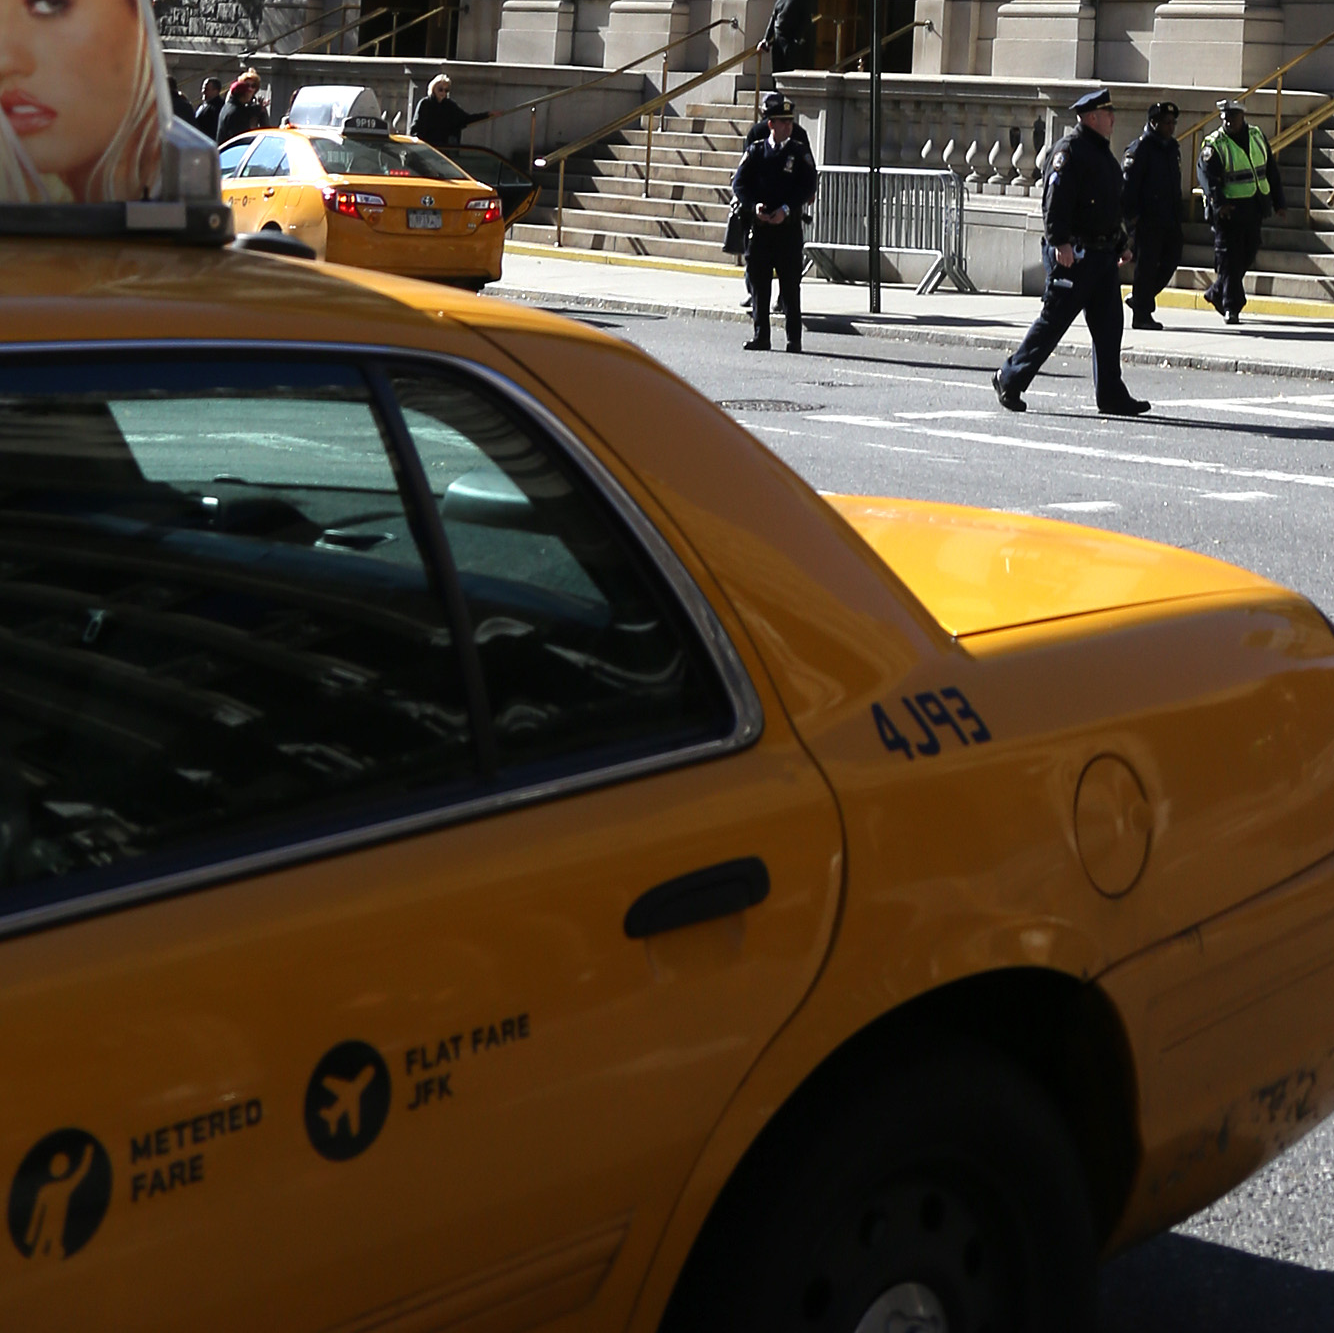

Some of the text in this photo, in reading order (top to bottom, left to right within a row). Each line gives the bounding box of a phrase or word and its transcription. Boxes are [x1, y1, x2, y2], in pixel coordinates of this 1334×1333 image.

[355, 118, 376, 128] 9P19
[871, 684, 992, 761] 4J93
[404, 1013, 531, 1076] FLAT FARE
[406, 1073, 453, 1112] JFK
[129, 1097, 264, 1165] METERED
[130, 1153, 205, 1204] FARE
